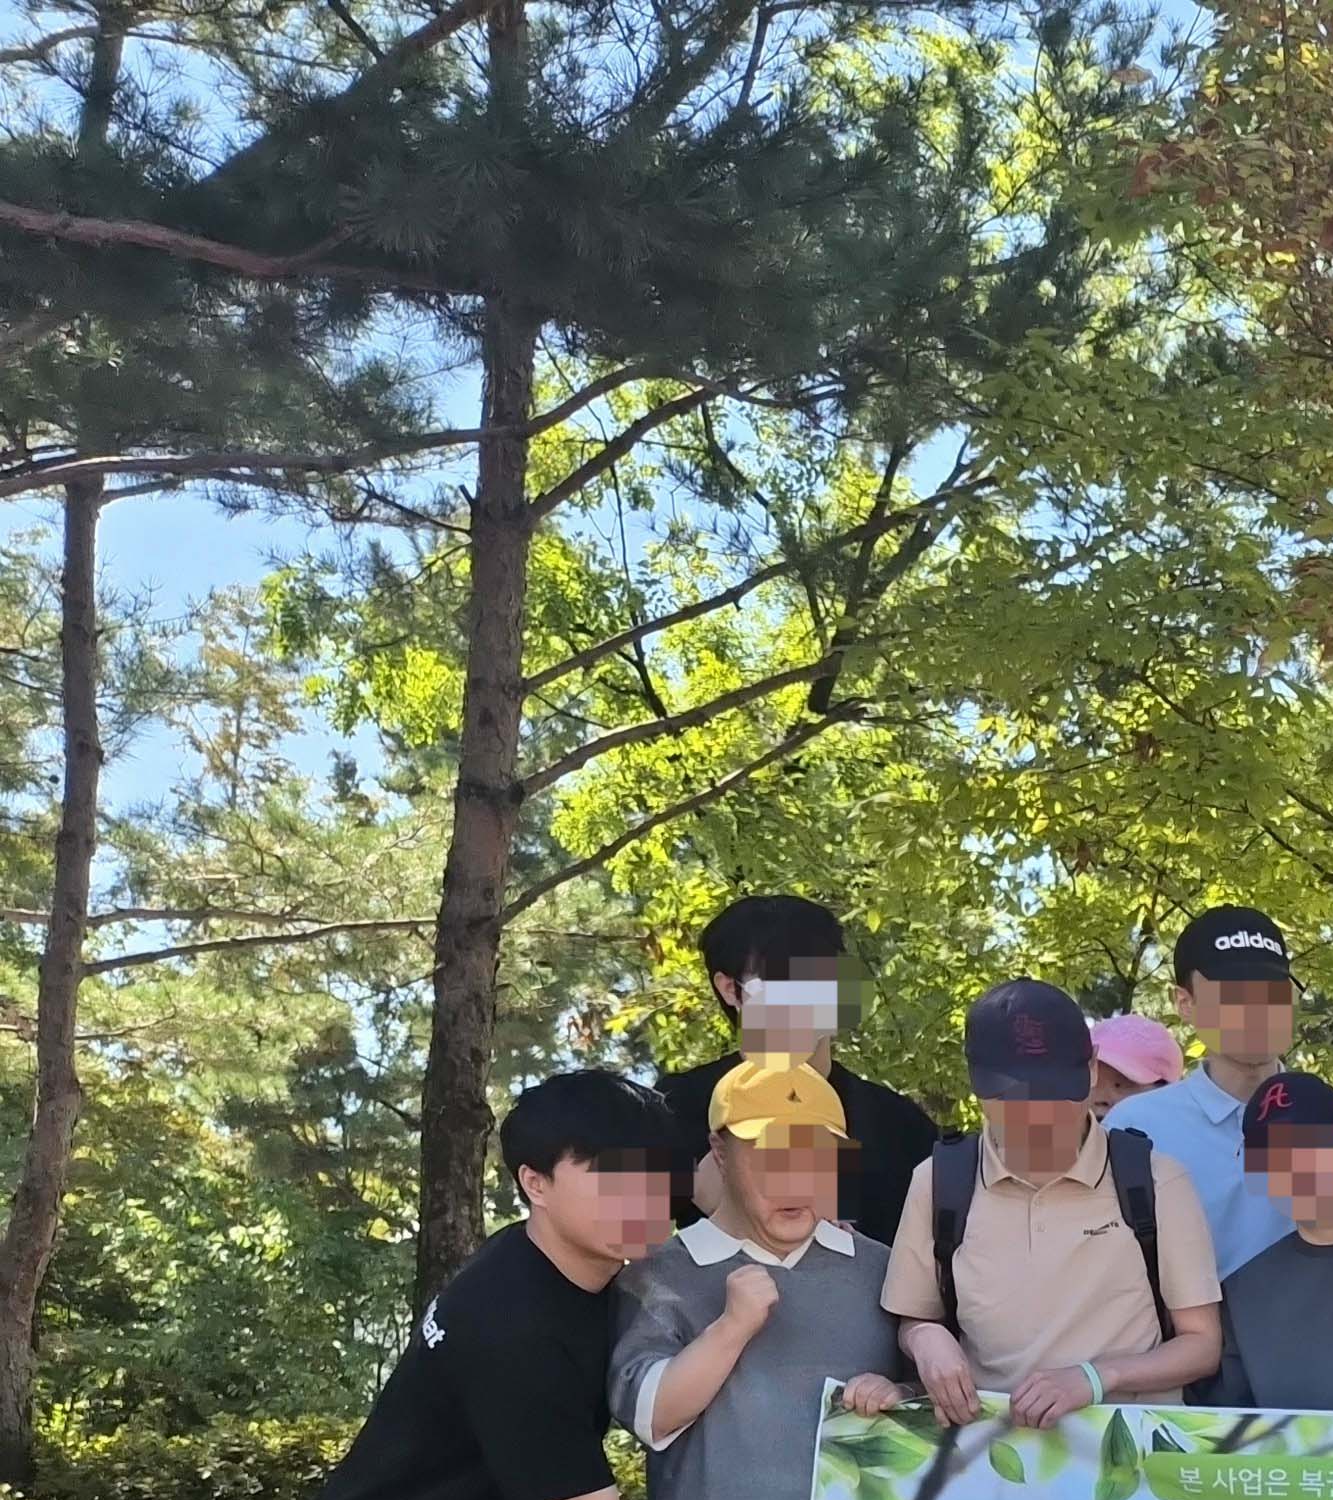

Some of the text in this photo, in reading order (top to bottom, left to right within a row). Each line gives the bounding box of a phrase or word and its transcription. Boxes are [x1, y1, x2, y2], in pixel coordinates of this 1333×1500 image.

[1215, 930, 1283, 956] adidas
[1179, 1466, 1203, 1493] 본
[1212, 1470, 1290, 1497] 사업은
